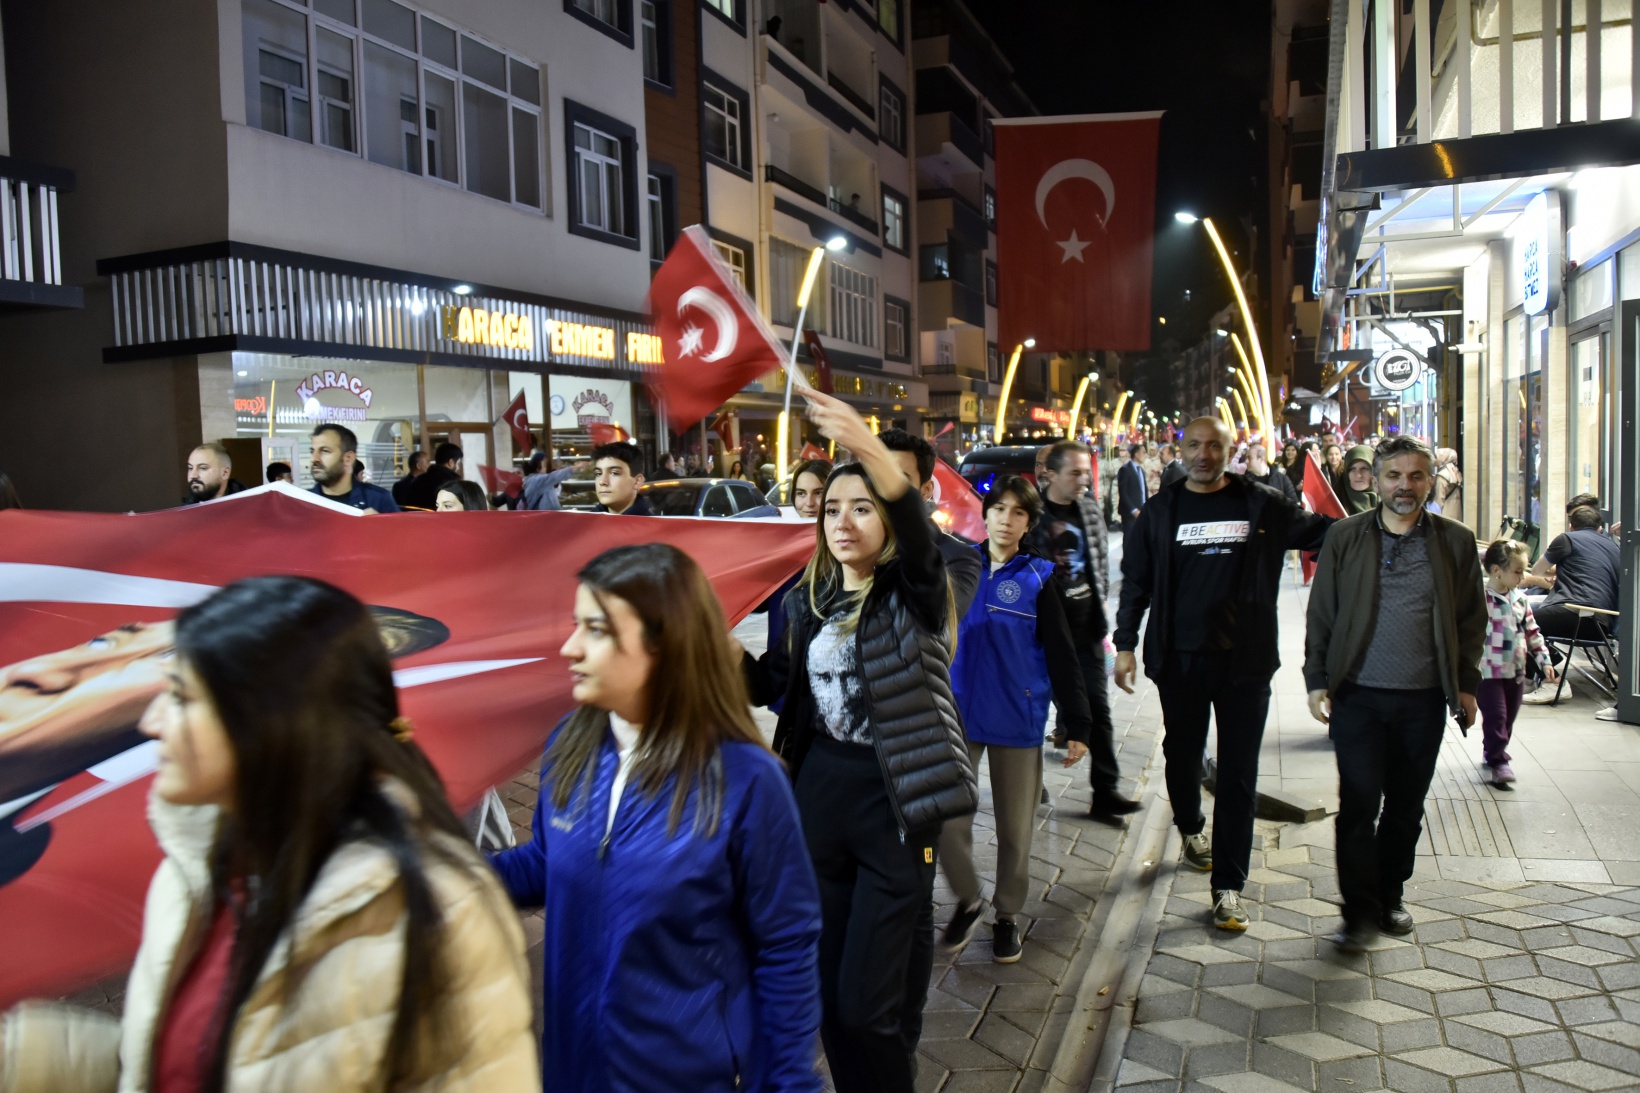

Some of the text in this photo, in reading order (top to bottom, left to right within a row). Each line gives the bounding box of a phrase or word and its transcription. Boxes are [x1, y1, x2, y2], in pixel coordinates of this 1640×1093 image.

[442, 305, 533, 351] KARACA
[551, 319, 615, 361] EKMEK
[295, 370, 373, 408] KARACA
[572, 389, 614, 417] KARACA
[341, 407, 366, 420] FIRINI
[1182, 524, 1249, 538] #BEACTIVE
